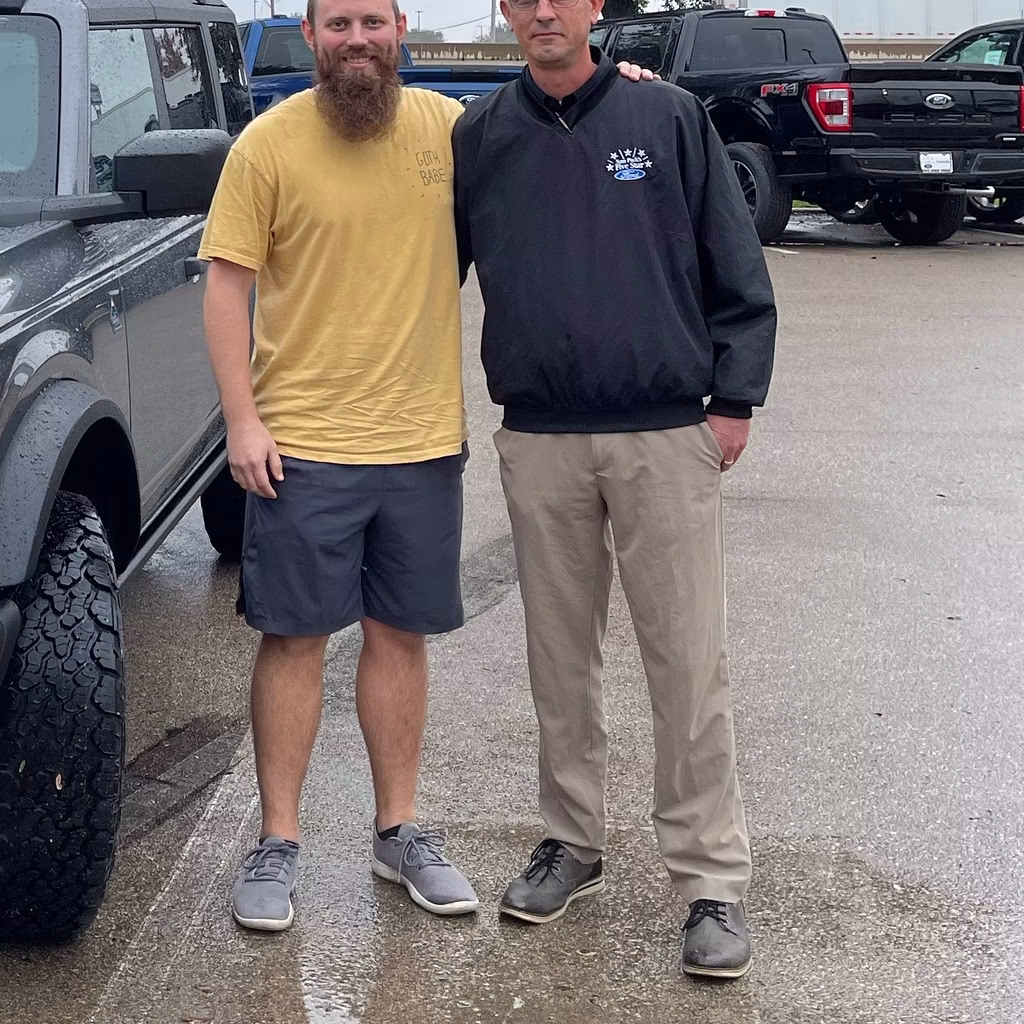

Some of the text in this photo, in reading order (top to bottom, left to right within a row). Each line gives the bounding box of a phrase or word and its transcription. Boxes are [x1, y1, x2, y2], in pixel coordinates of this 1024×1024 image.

[760, 82, 799, 97] FX4
[416, 150, 441, 167] GOTH
[419, 168, 447, 187] BABE
